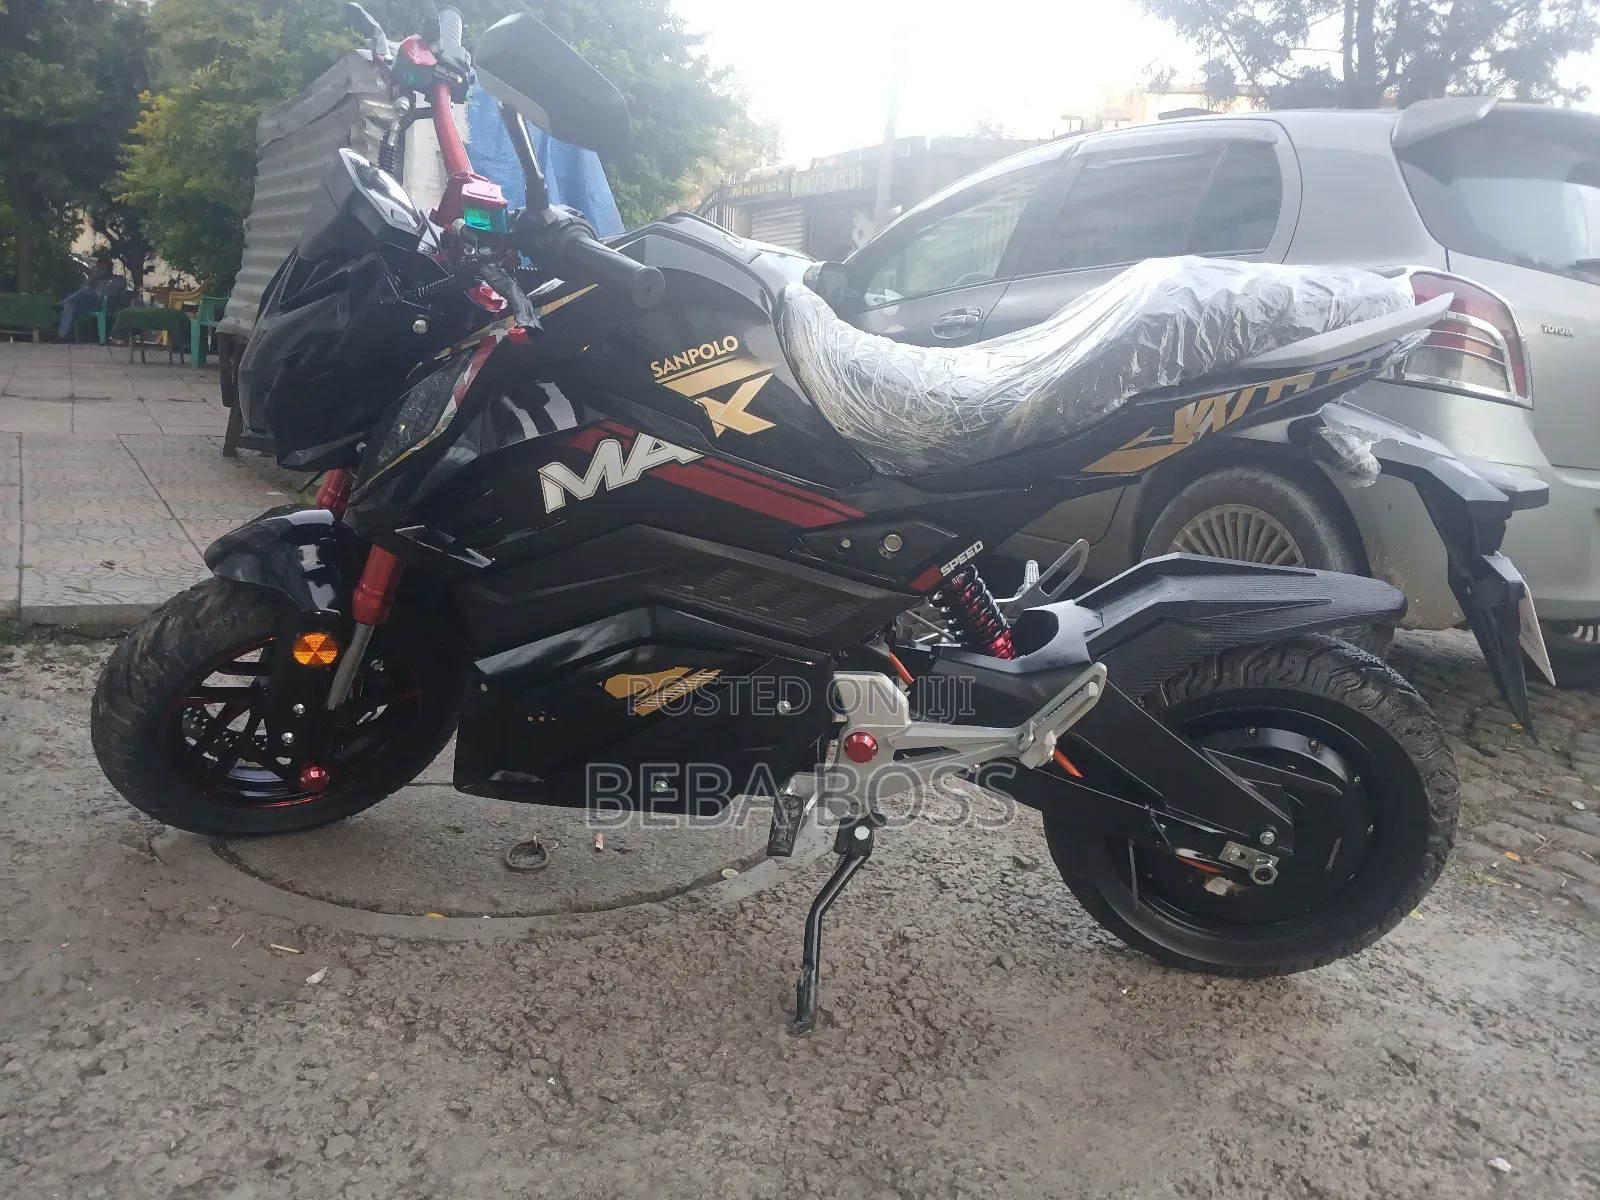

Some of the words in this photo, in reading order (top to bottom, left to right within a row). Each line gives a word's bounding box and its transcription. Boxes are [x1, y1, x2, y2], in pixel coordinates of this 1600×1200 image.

[1541, 323, 1574, 337] TOYOTA
[650, 335, 739, 378] SANPOLO
[940, 540, 984, 577] SPEED
